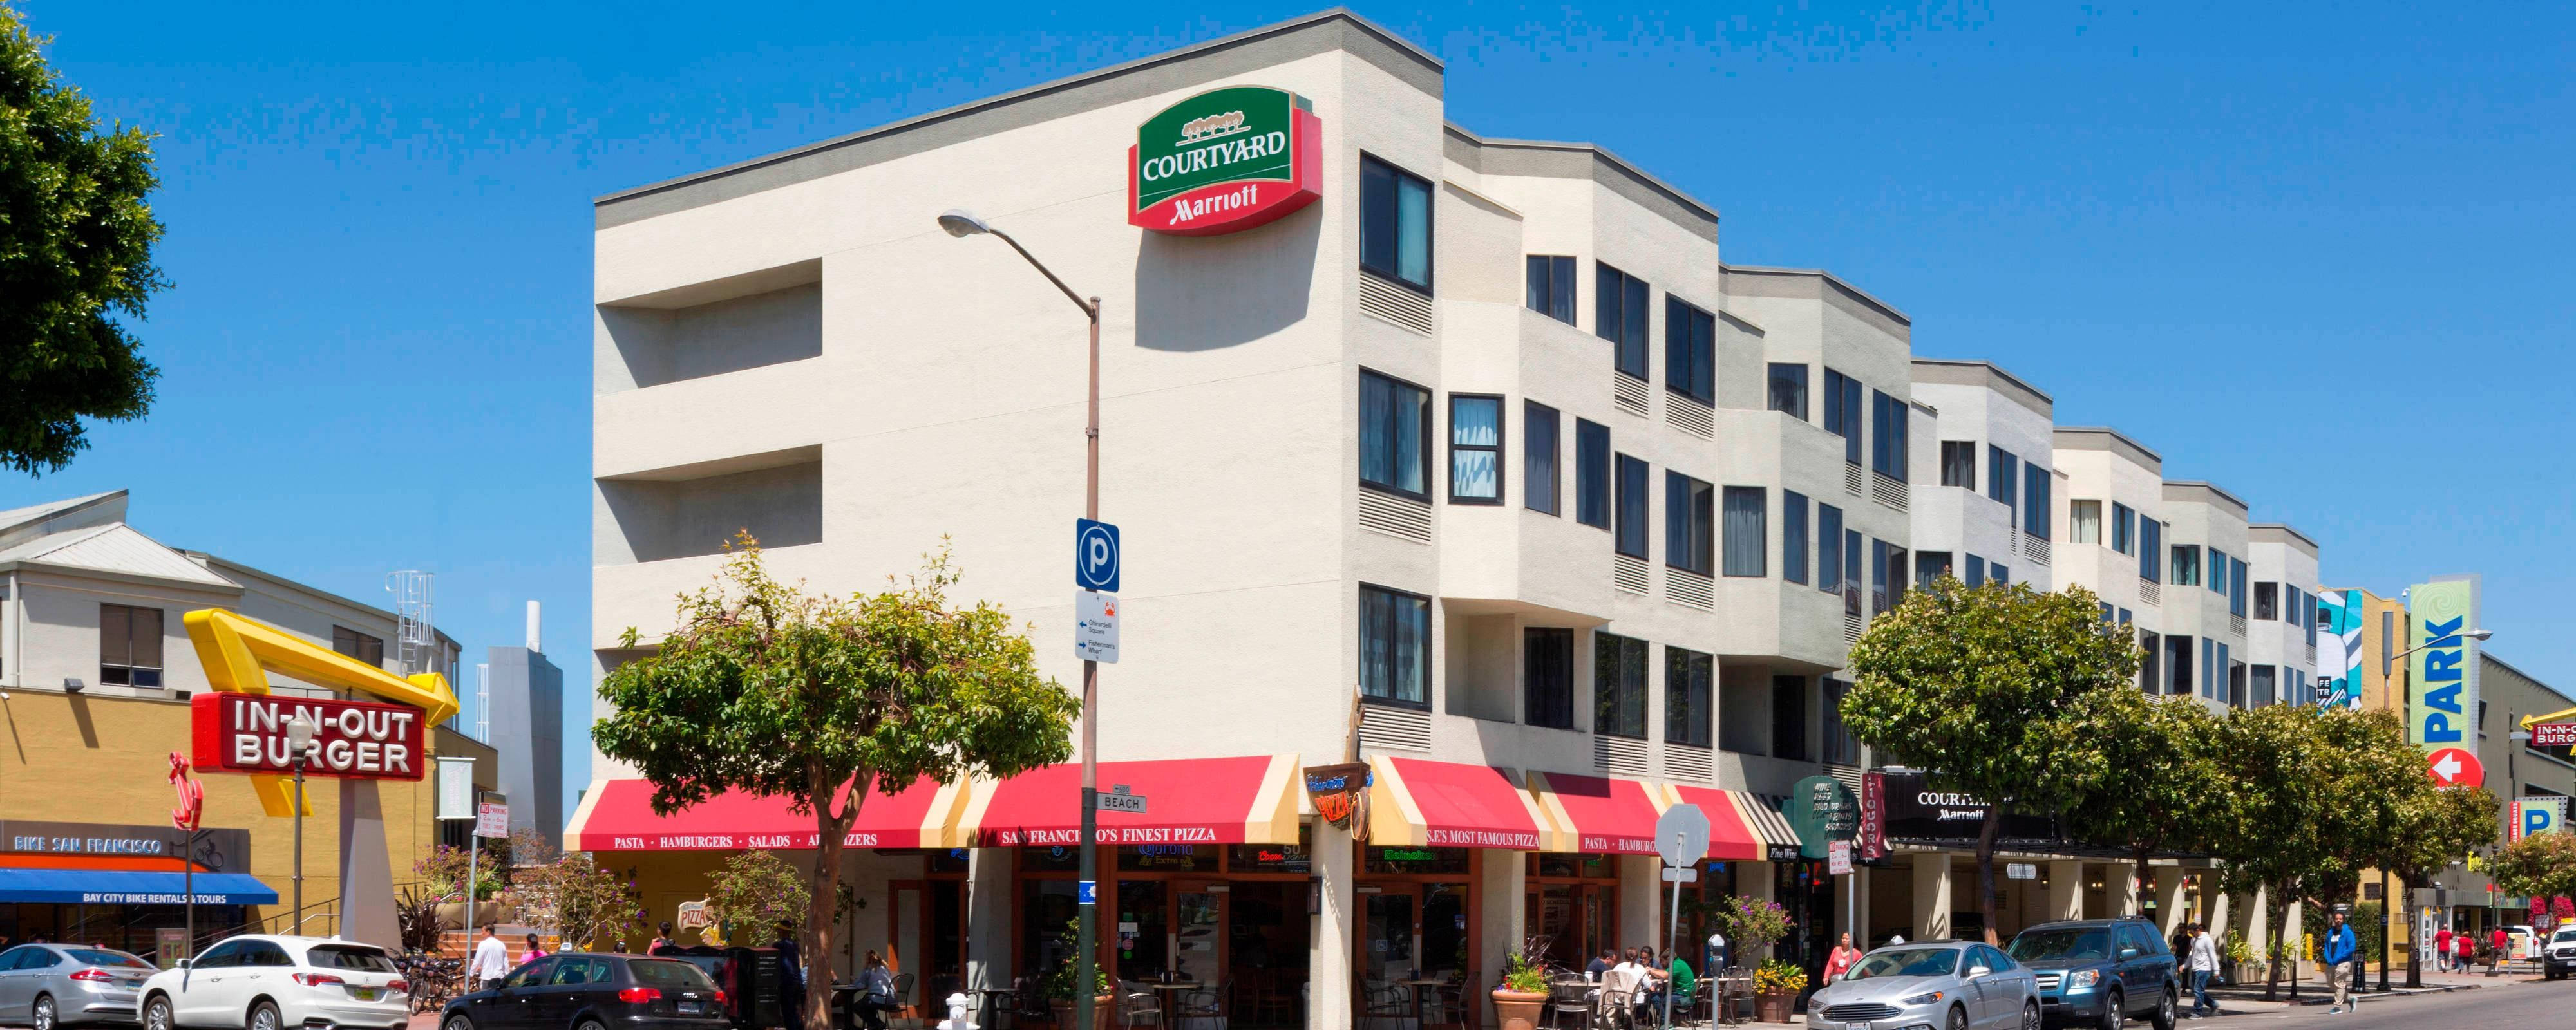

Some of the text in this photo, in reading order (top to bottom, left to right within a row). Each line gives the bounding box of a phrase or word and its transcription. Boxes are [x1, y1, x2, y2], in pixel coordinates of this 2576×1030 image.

[1143, 131, 1286, 182] COURTYARD
[1169, 183, 1258, 225] Marriott
[1088, 619, 1112, 630] Ghirardelli
[1088, 639, 1115, 650] Fisherman's
[1088, 646, 1103, 655] Wharf
[2425, 615, 2463, 743] PARK
[235, 700, 413, 741] IN-N-OUT
[235, 734, 410, 772] BURGER
[1104, 797, 1139, 809] BEACH
[1315, 791, 1350, 824] PIZZA
[1866, 776, 1876, 855] LIQUORS
[1937, 809, 1984, 821] Marriott
[2526, 810, 2550, 836] P
[614, 837, 645, 848] PASTA
[660, 836, 733, 848] HAMBURGERS
[748, 835, 790, 847] SALADS
[1002, 828, 1217, 844] SAN FRANCIO'S FINEST PIZZA
[1450, 830, 1476, 844] MOST
[1477, 832, 1513, 845] FAMOUS
[1515, 834, 1539, 847] PIZZA
[14, 836, 162, 854] BIKE SAN FRANCISCO
[1139, 844, 1193, 857] Corona
[1283, 845, 1301, 855] 50
[1585, 837, 1608, 850] PASTA
[1385, 849, 1437, 861] Heineken
[1770, 847, 1798, 859] Fine Wine
[83, 894, 102, 902] BAY
[103, 894, 125, 903] CITY
[126, 894, 147, 903] BIKE
[148, 894, 187, 903] RENTALS
[197, 895, 227, 904] TOURS
[681, 908, 706, 928] PIZZA
